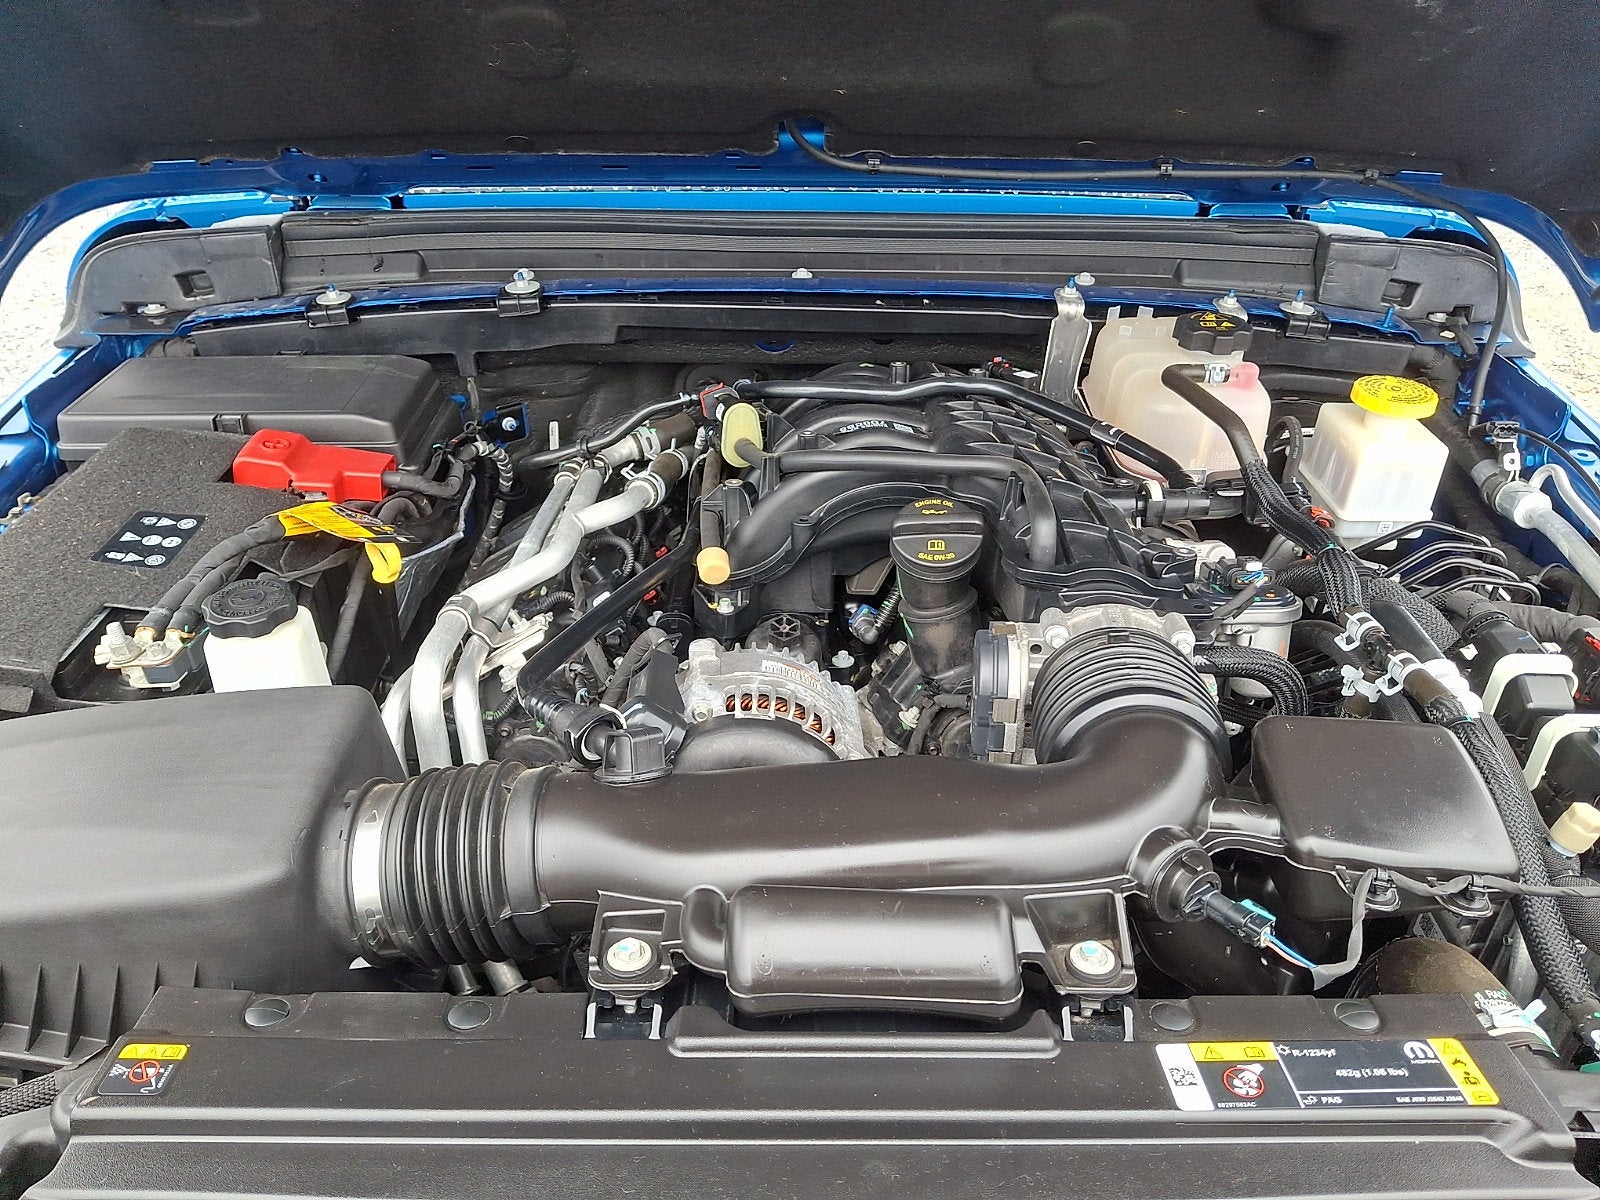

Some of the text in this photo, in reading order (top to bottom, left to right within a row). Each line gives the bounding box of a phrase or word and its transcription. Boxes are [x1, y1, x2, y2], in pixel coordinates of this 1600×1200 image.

[915, 500, 954, 508] ENGINE OIL
[934, 553, 955, 561] 0W-20
[1292, 1048, 1337, 1058] R-1234yf
[1335, 1068, 1361, 1078] 482g
[1388, 1067, 1409, 1077] lbs)
[1321, 1096, 1343, 1104] PAG
